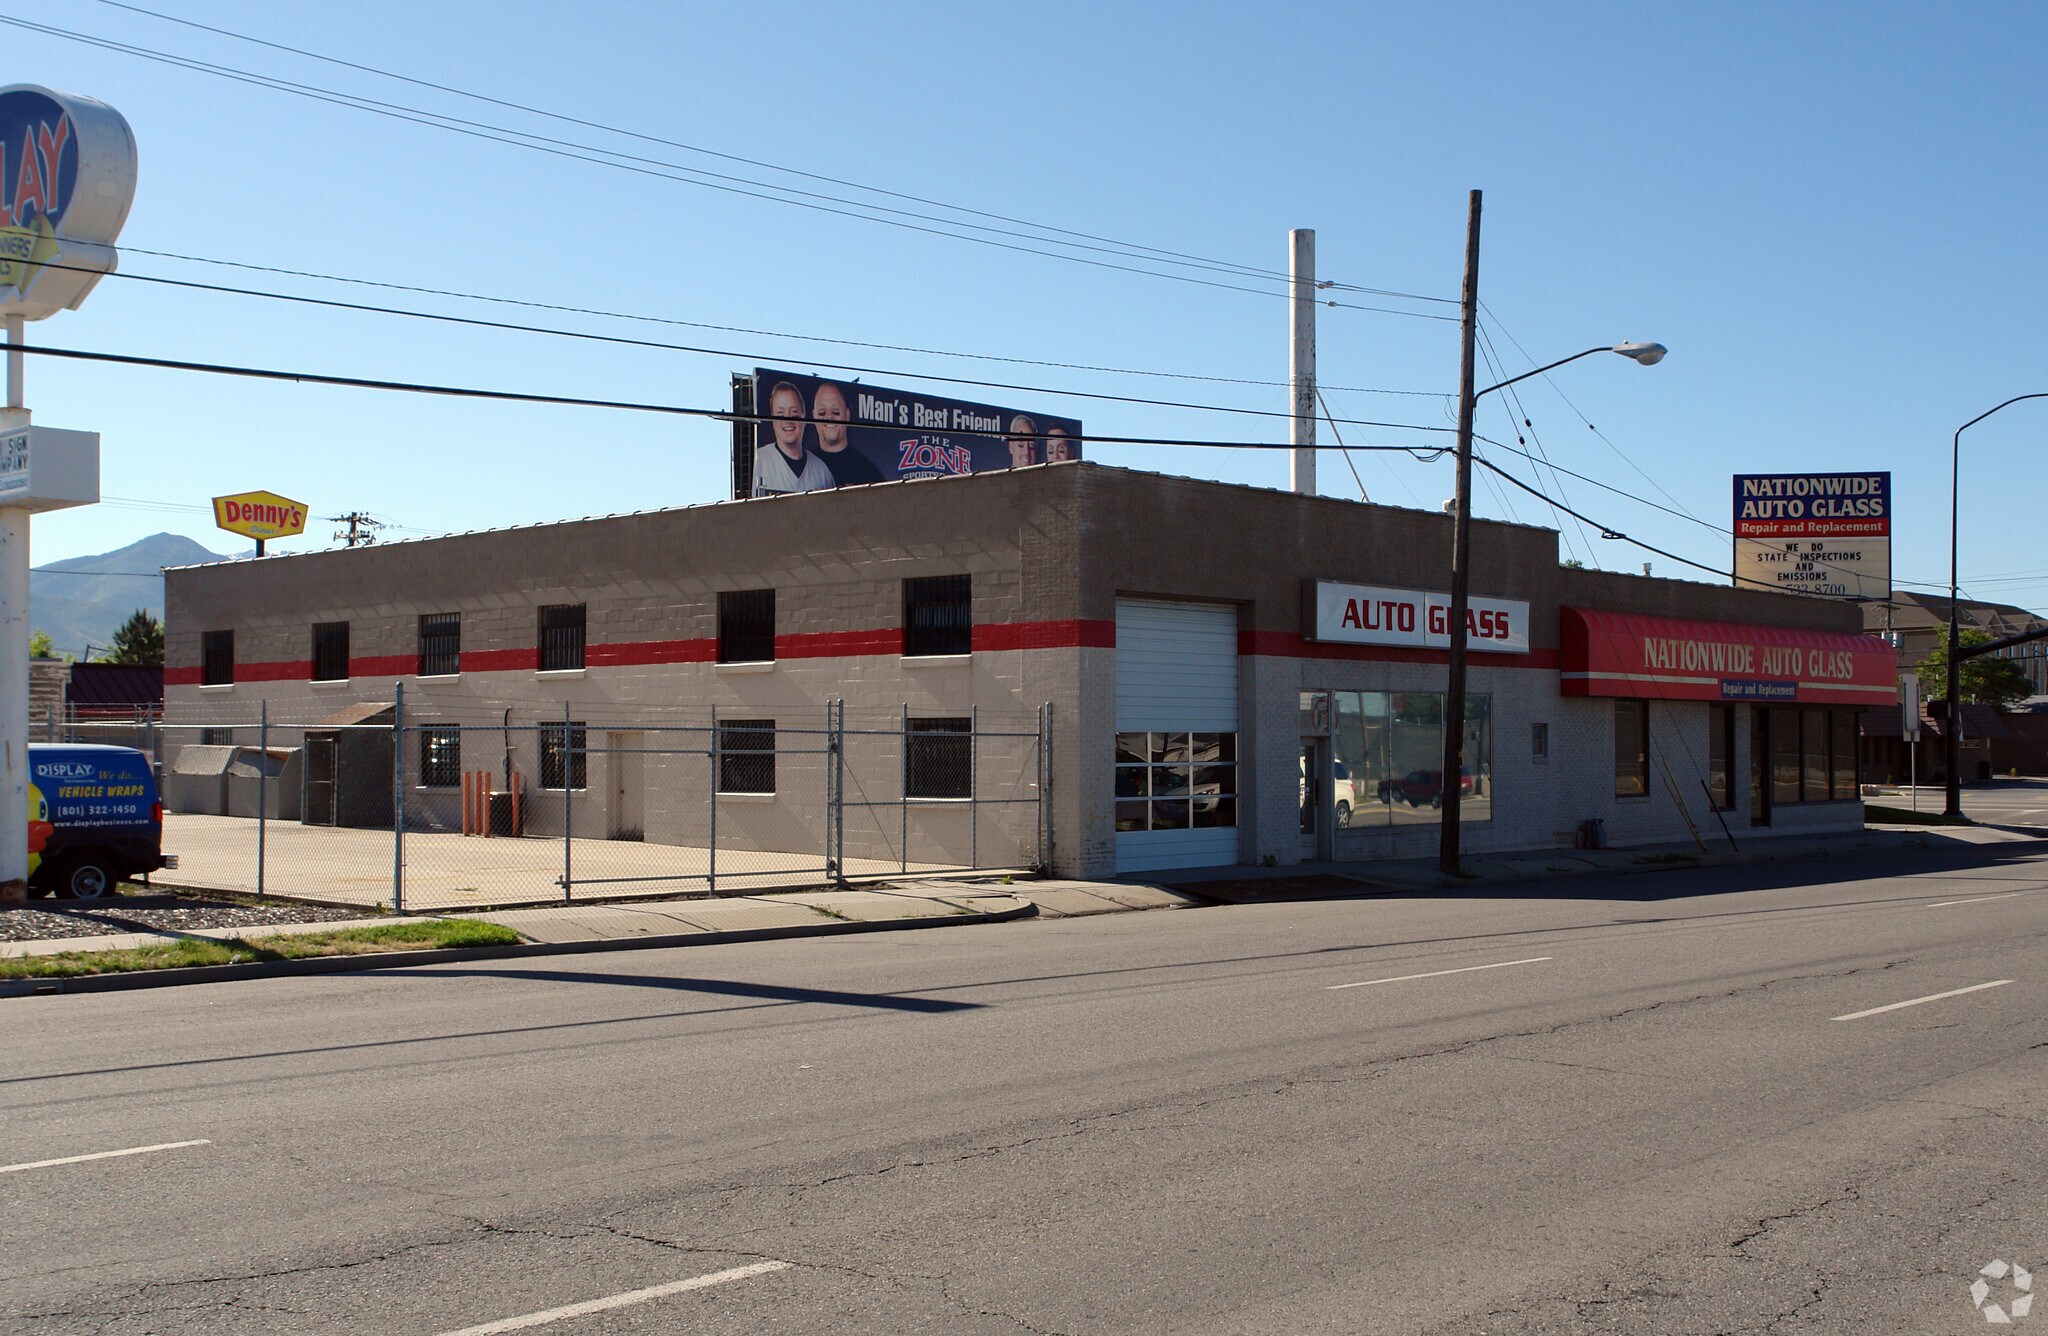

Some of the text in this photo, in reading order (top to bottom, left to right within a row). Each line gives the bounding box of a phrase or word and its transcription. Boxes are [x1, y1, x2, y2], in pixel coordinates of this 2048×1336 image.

[858, 393, 1000, 432] Man's Best Friend
[8, 434, 28, 454] SIGN
[921, 435, 950, 448] THE
[898, 439, 972, 475] ZONE
[1742, 477, 1882, 497] NATIONWIDE
[224, 500, 302, 529] Denny's
[1740, 498, 1884, 518] AUTO GLASS
[1741, 521, 1882, 535] Repair and Replacement
[1786, 543, 1823, 551] WE DO
[1757, 552, 1861, 562] STATE INSPECTIONS
[1795, 562, 1814, 571] AND
[1777, 572, 1827, 581] EMISSIONS
[1341, 598, 1415, 632] AUTO
[1644, 637, 1853, 679] NATIONWIDE AUTO GLASS
[1722, 682, 1795, 697] Repair and Replacement
[38, 764, 92, 776] DISPLAY
[98, 771, 115, 780] We
[59, 785, 144, 798] VEHICLE WRAPS
[57, 804, 136, 818] (801) 322-1450
